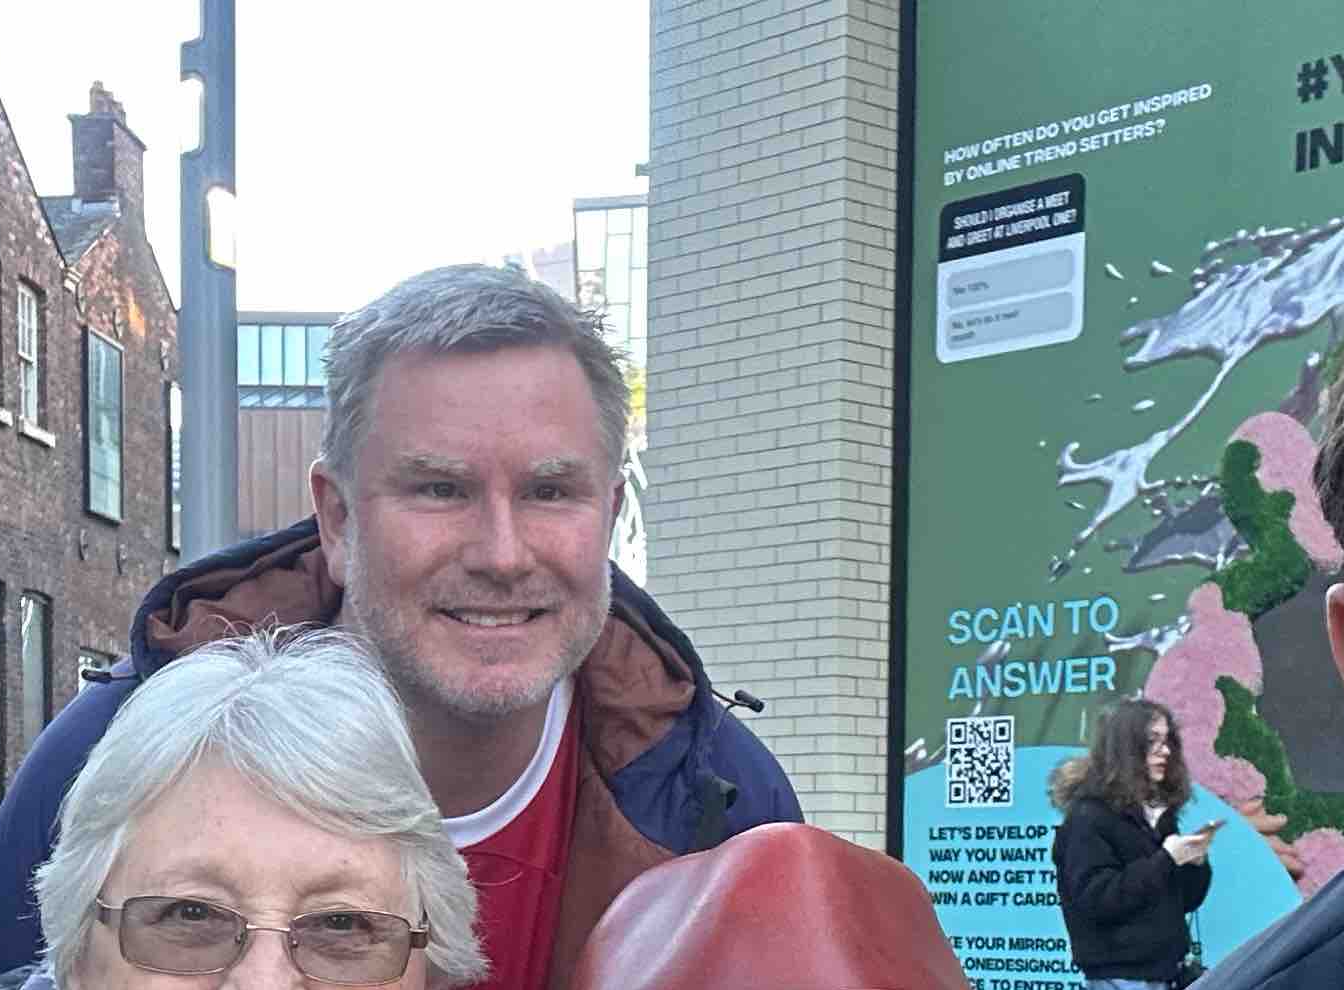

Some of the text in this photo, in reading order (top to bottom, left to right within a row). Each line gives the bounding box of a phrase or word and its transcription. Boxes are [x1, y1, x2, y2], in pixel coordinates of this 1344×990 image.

[944, 83, 1213, 165] HOW OFTEN DO YOU GET INSPIRED
[943, 118, 1166, 187] BY ONLINE TREND SETTERS?
[948, 597, 1118, 645] SCAN TO
[948, 656, 1116, 700] ANSWER
[929, 827, 972, 841] LET'S
[975, 825, 1048, 840] DEVELOP
[930, 847, 1048, 862] WAY YOU WANT
[929, 870, 964, 885] NOW
[968, 870, 1001, 884] AND
[1004, 870, 1035, 885] GET
[929, 891, 1062, 906] WIN A GIFT CARD
[965, 936, 1006, 950] YOUR
[1009, 938, 1067, 951] MIRROR
